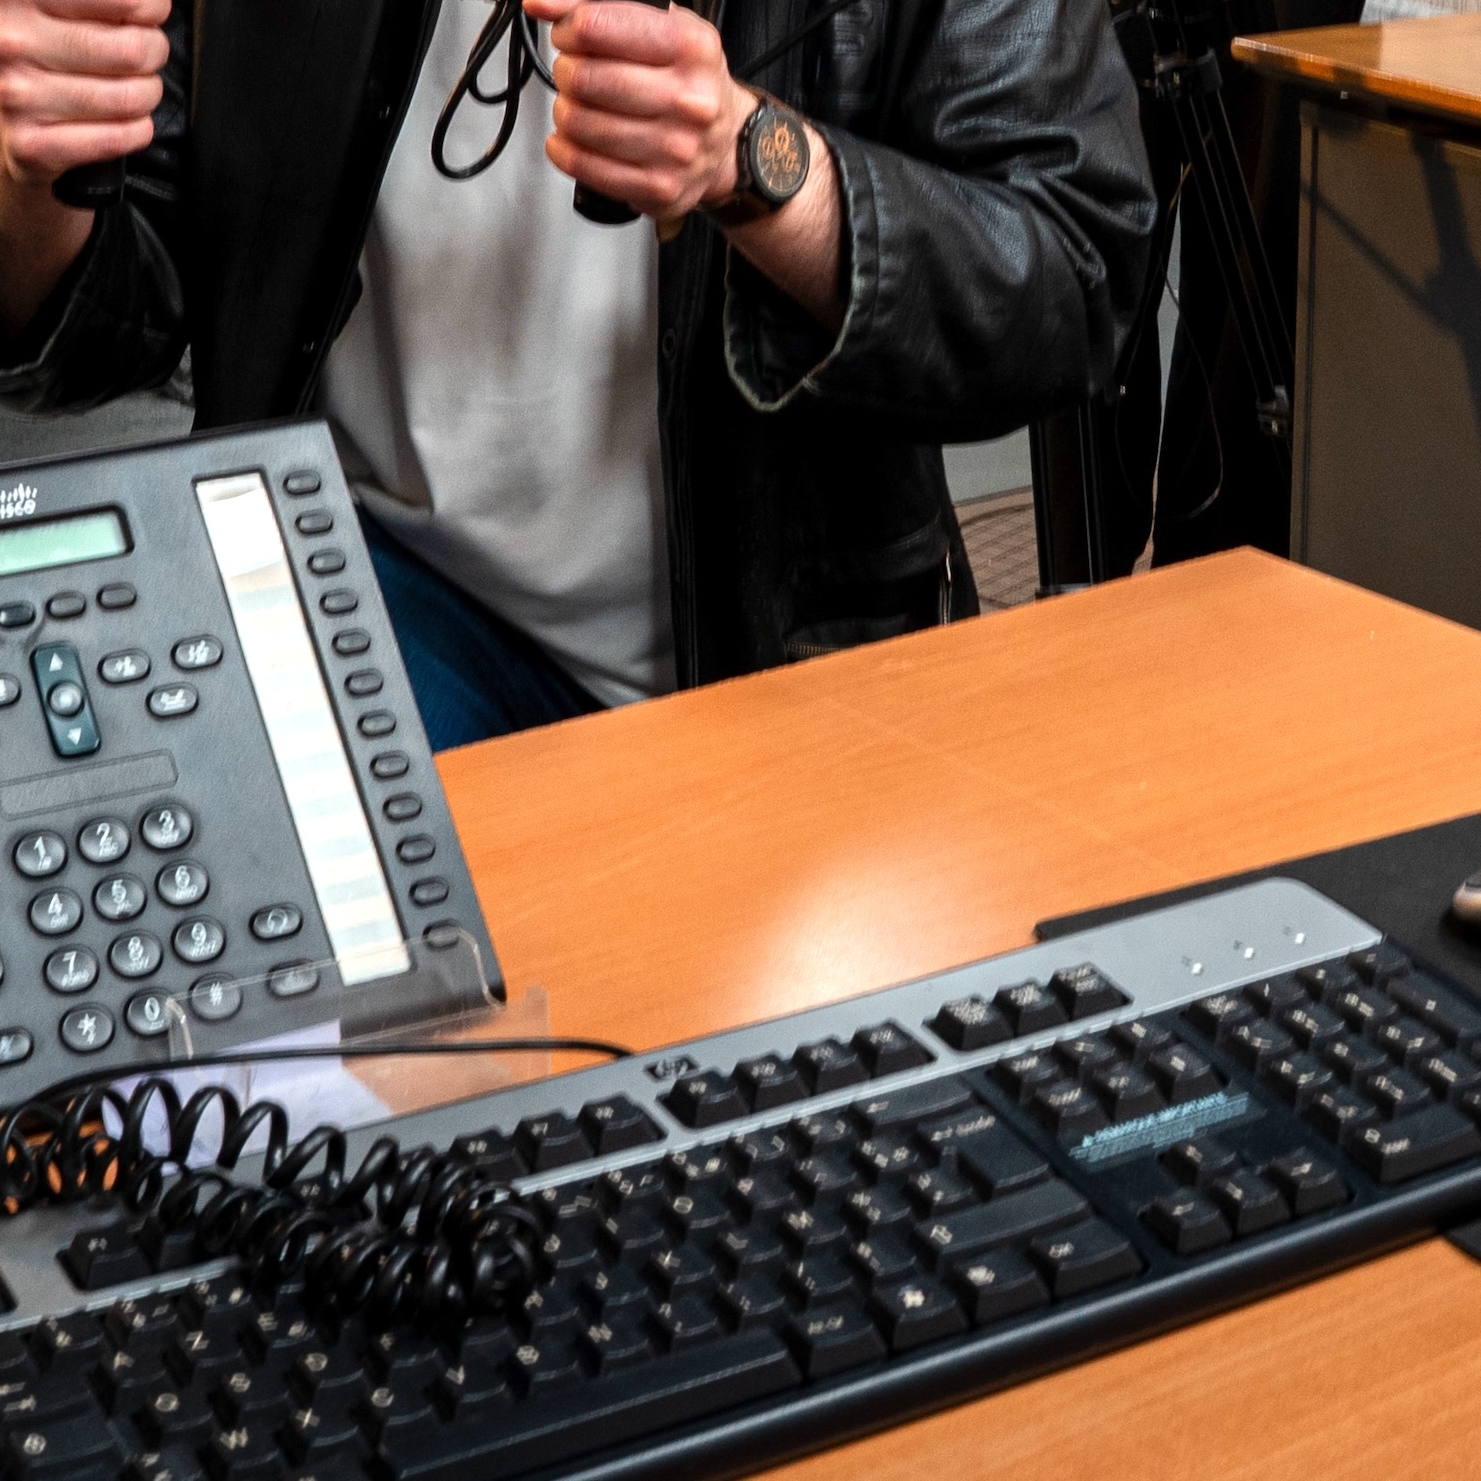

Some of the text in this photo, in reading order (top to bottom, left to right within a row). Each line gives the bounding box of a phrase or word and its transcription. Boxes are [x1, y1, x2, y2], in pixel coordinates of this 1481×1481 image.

[96, 822, 111, 846] 2
[175, 865, 190, 888] 6
[112, 879, 126, 903] 5
[48, 893, 62, 915] 4
[191, 922, 206, 946] 9
[128, 936, 144, 961] 8
[62, 951, 77, 975] 7
[145, 997, 160, 1021] 0
